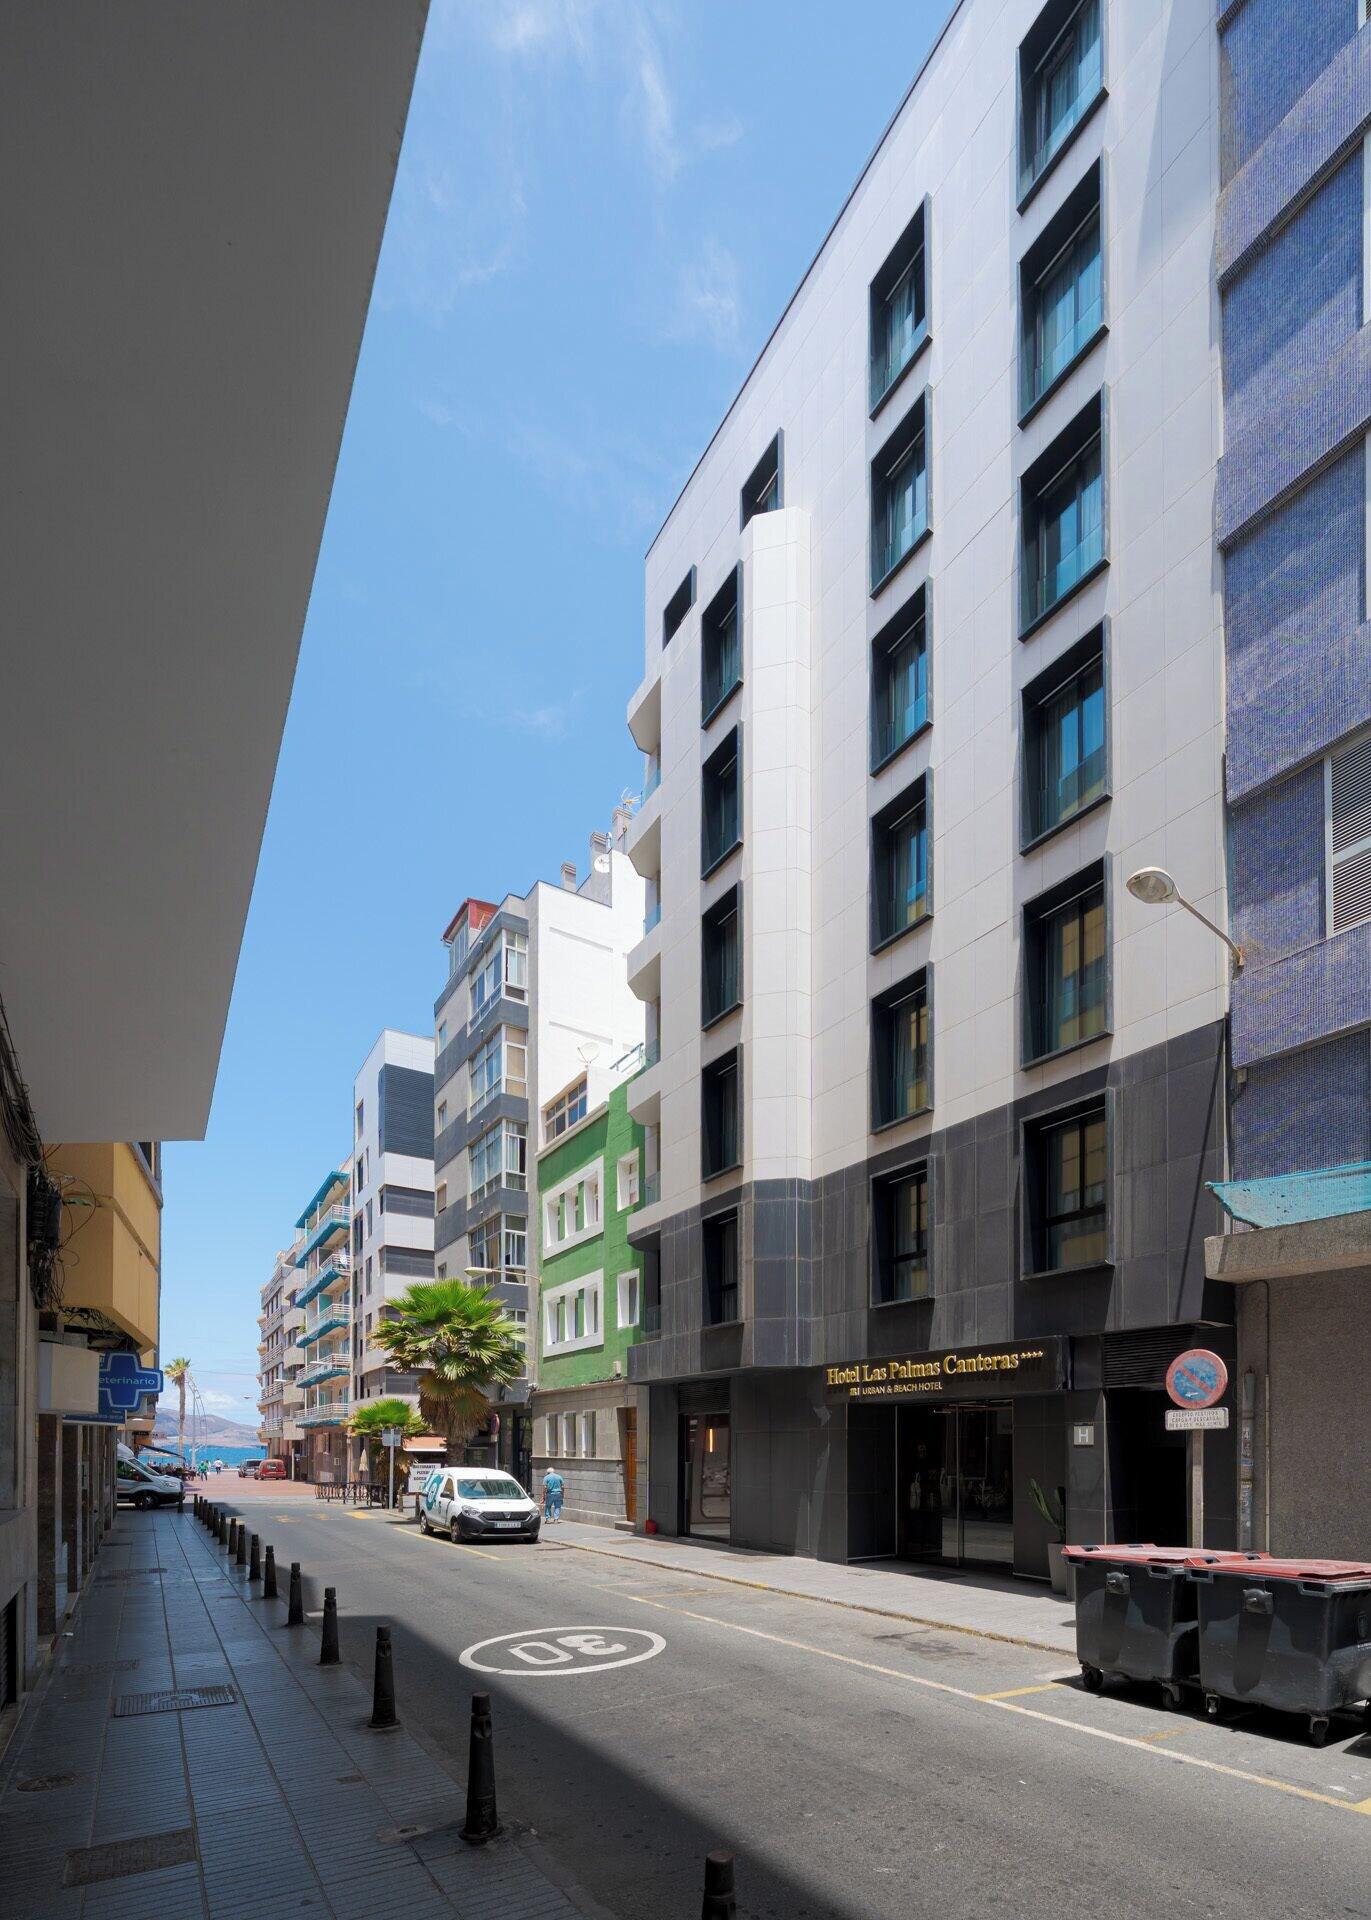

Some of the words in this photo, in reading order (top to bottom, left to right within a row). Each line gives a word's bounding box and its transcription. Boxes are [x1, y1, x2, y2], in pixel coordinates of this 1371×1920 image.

[827, 1366, 860, 1385] Hotel
[862, 1364, 887, 1382] Las
[888, 1360, 940, 1380] Palmas
[943, 1353, 1019, 1374] Canteras
[99, 1377, 155, 1385] eterinario
[862, 1386, 885, 1395] URBAN
[886, 1385, 893, 1394] &
[894, 1383, 917, 1393] BEACH
[919, 1381, 943, 1391] HOTEL
[1079, 1428, 1089, 1443] H
[508, 1634, 627, 1665] 30
